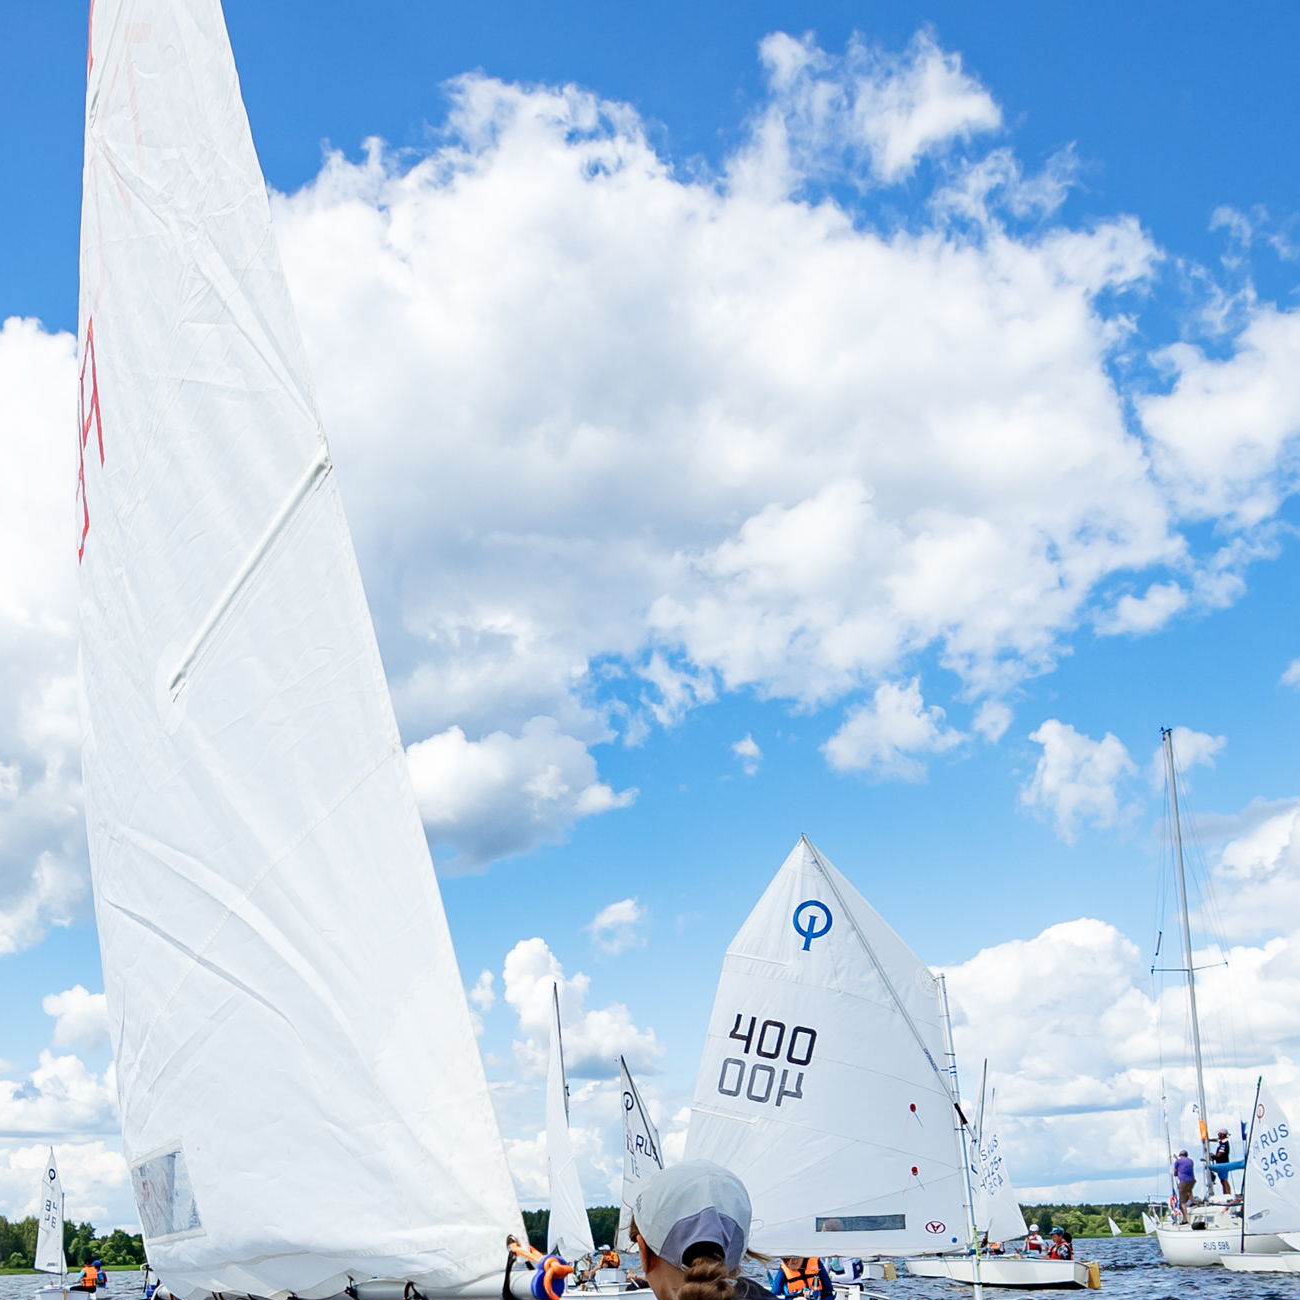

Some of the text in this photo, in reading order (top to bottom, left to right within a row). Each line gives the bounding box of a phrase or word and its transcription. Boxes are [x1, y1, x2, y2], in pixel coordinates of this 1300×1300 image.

[729, 1013, 817, 1066] 400
[1260, 1123, 1289, 1149] RUS
[1261, 1147, 1288, 1171] 346
[1203, 1241, 1230, 1251] RUS 598
